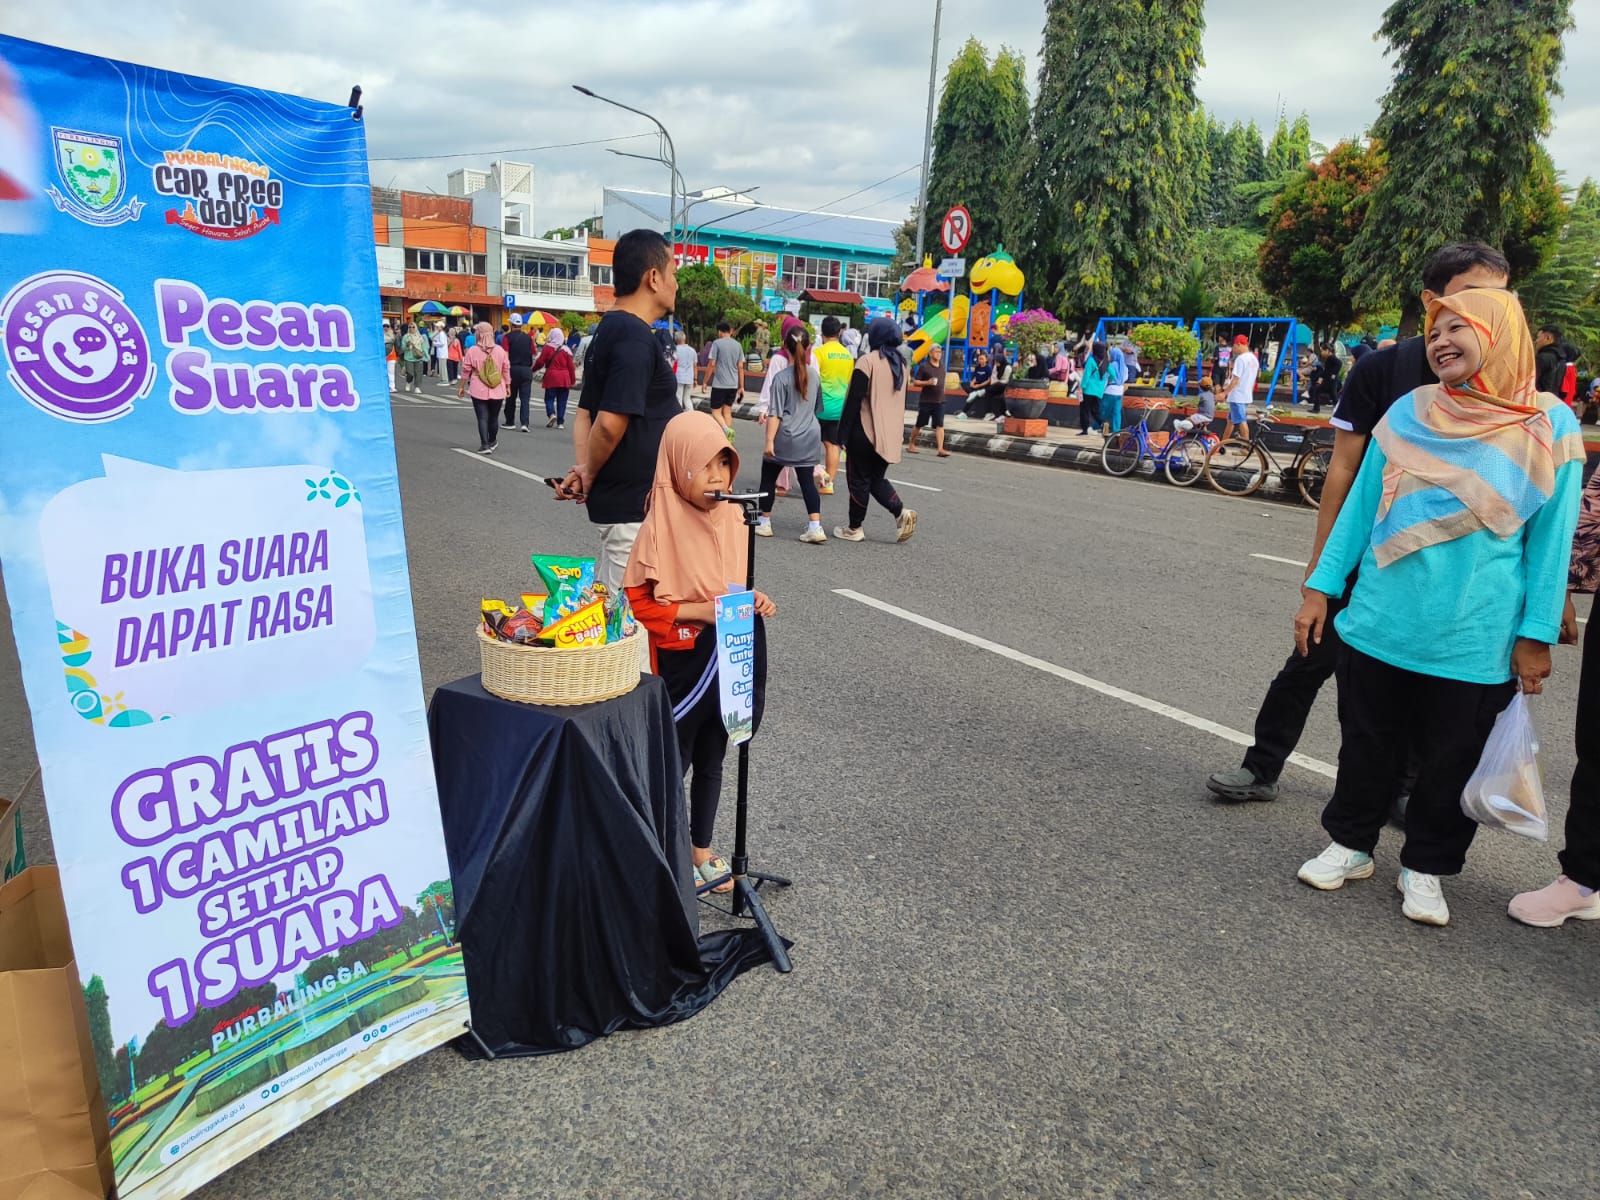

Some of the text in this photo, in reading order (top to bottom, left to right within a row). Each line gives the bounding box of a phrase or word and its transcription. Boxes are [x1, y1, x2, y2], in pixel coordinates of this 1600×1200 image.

[164, 150, 269, 178] PURBALINGGA
[14, 291, 139, 366] Pesan Suara
[158, 281, 353, 349] Pesan
[172, 352, 357, 411] Suara
[100, 529, 328, 604] BUKA SUARA
[114, 584, 333, 668] DAPAT RASA
[558, 613, 602, 644] CHIKI
[575, 624, 603, 643] Balls
[725, 632, 754, 648] Puny
[111, 711, 378, 846] GRATIS
[160, 778, 389, 899] CAMILAN
[198, 847, 343, 938] SETIAP
[148, 874, 403, 1028] 1 SUARA
[211, 960, 369, 1053] PURBALINGGA
